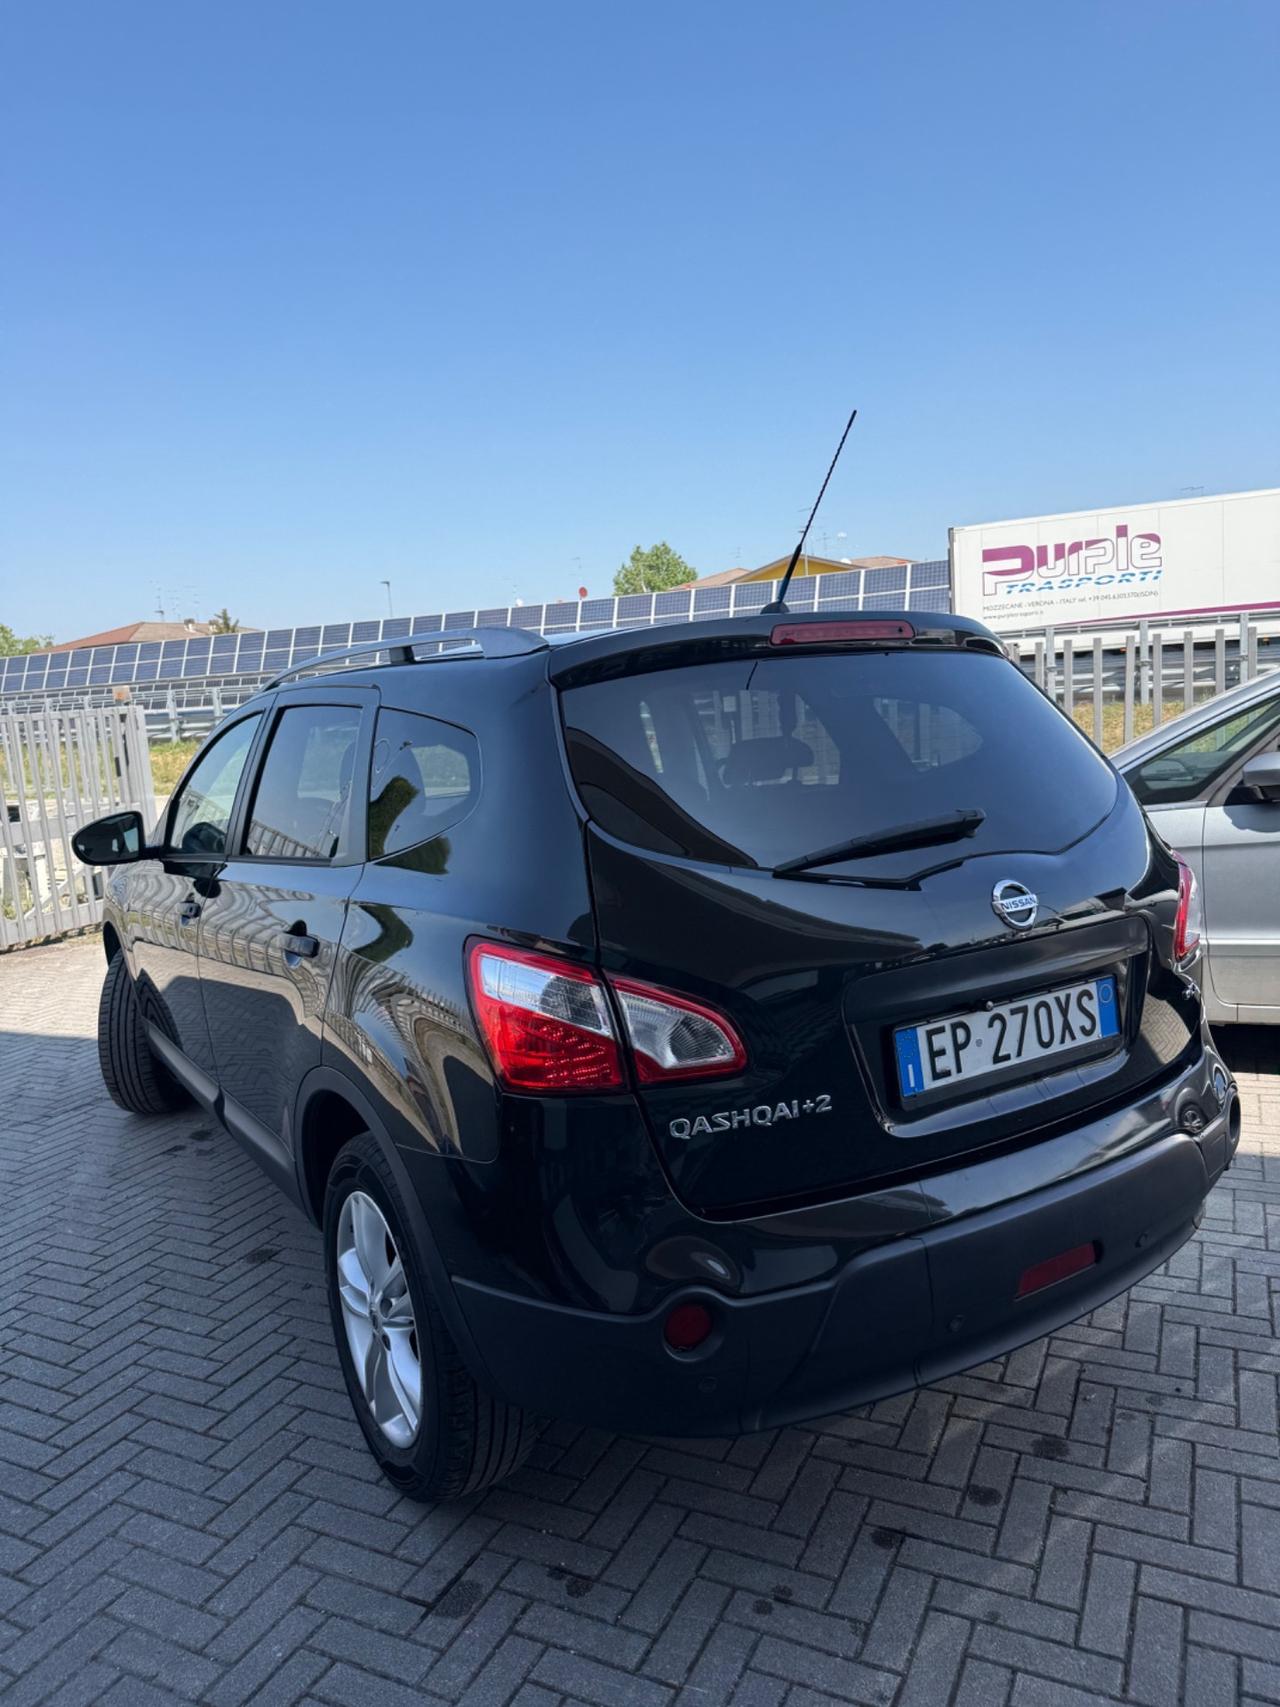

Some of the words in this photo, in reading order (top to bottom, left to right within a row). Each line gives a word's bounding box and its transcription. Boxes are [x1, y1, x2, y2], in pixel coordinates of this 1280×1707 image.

[1006, 570, 1162, 595] TRASPORTI
[983, 602, 1023, 611] MOZZECANE
[1027, 599, 1054, 608] VERONA
[1001, 897, 1036, 911] NISSAN
[925, 1021, 971, 1081] EP
[988, 989, 1097, 1065] 270XS
[669, 1094, 832, 1139] QASHQAI+2
